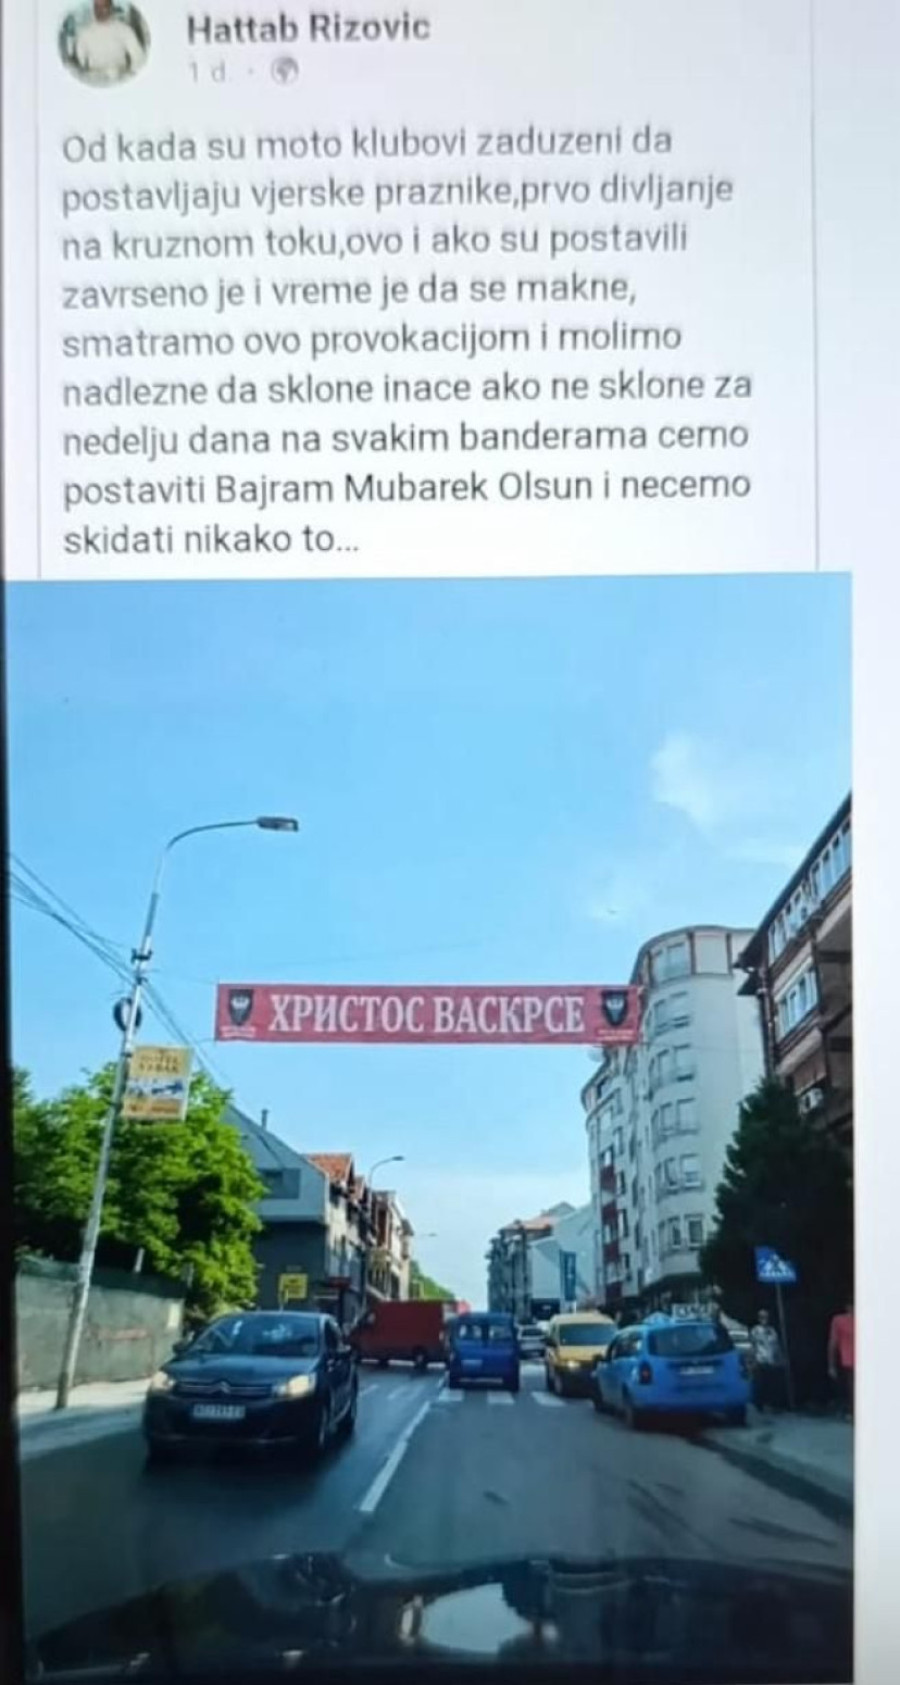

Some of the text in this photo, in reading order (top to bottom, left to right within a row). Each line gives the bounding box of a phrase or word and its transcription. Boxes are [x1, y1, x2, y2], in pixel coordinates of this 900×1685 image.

[187, 11, 431, 45] Hattab Rizovic
[190, 60, 226, 83] 1 d
[63, 123, 673, 163] Od kada su moto klubovi zaduzeni da
[63, 172, 734, 218] postavljaju vjerske praznike,prvo divljanje
[62, 222, 687, 260] na kruznom toku,ovo i ako su postavili
[62, 271, 636, 313] zavrseno je i vreme je da se makne,
[62, 319, 682, 361] smatramo ovo provokacijom i molimo
[62, 368, 753, 407] nadlezne da sklone inace ako ne sklone za
[63, 421, 749, 462] nedelju dana na svakim banderama cemo
[63, 470, 752, 513] postaviti Bajram Mubarek Olsun i necemo
[63, 523, 360, 555] skidati nikako to...
[268, 994, 585, 1034] ХРИСТОС ВАСКРСЕ
